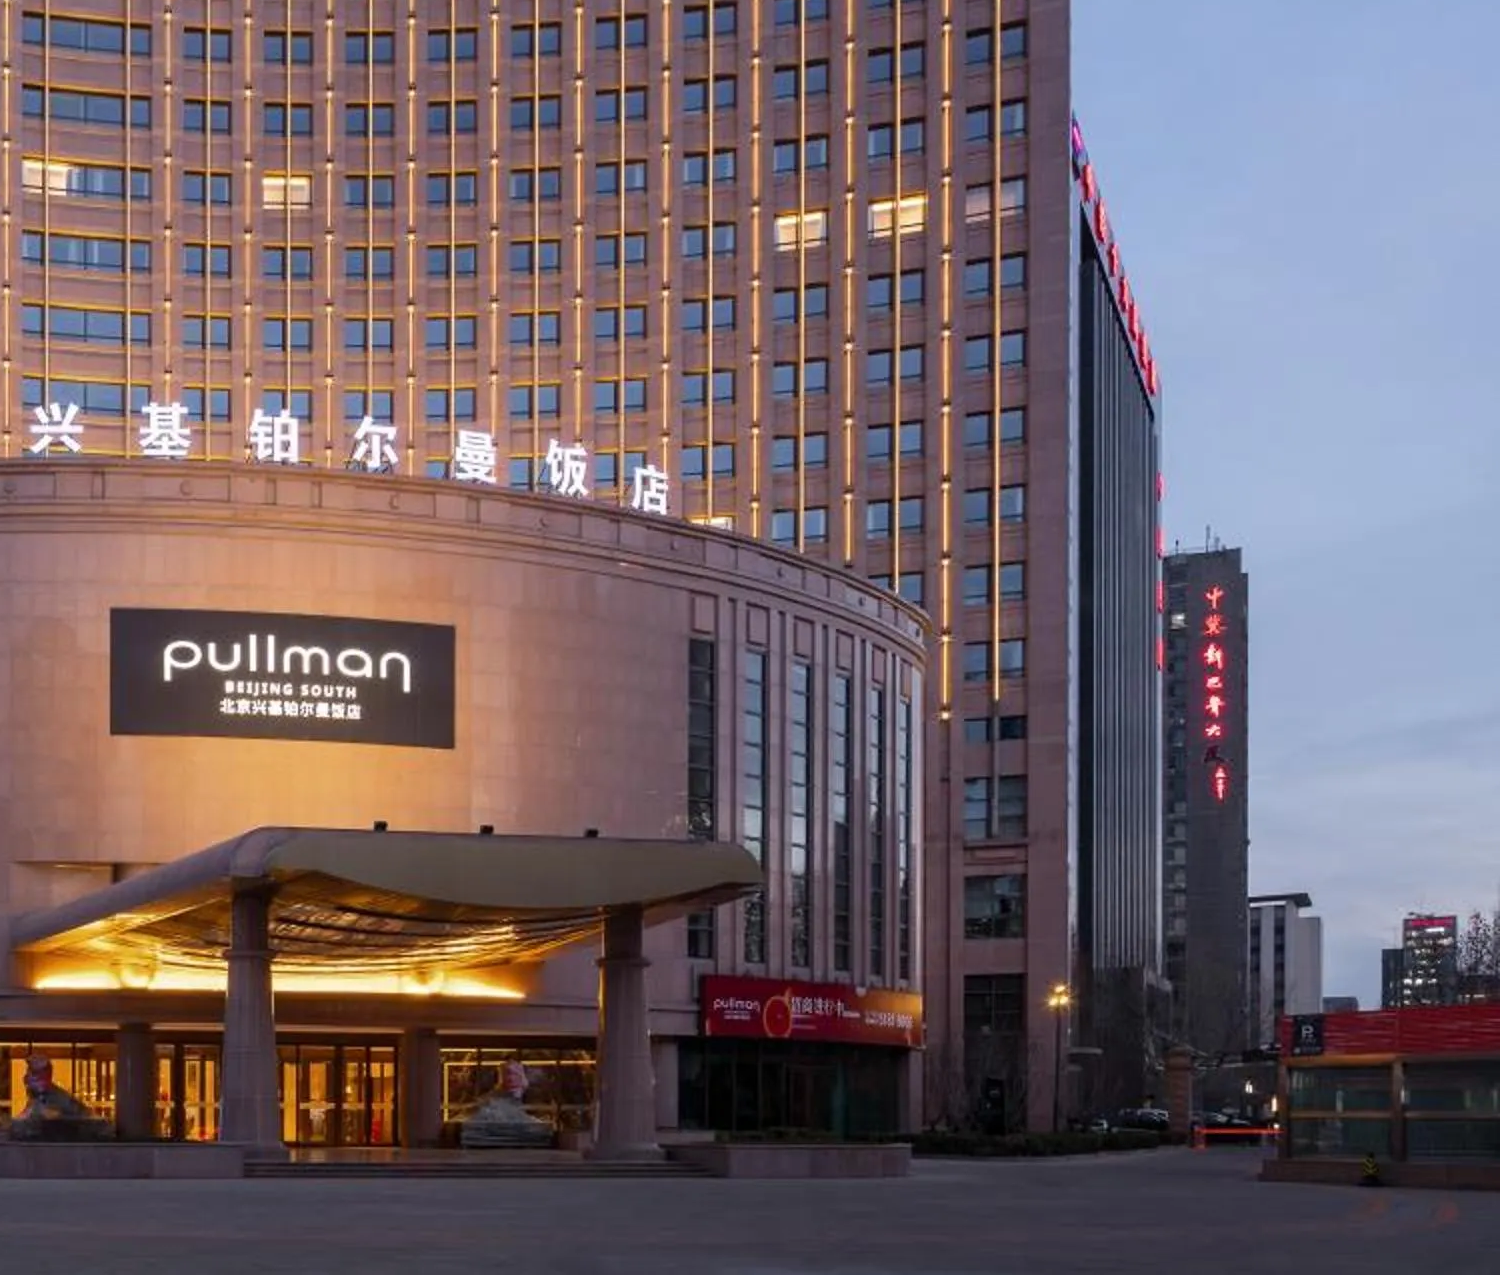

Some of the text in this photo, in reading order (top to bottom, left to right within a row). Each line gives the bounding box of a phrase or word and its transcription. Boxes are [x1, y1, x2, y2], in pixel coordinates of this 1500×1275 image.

[163, 633, 411, 693] pullman
[224, 680, 357, 699] BEIJING SOUTH
[219, 698, 362, 720] 北京兴基铂尔曼饭店
